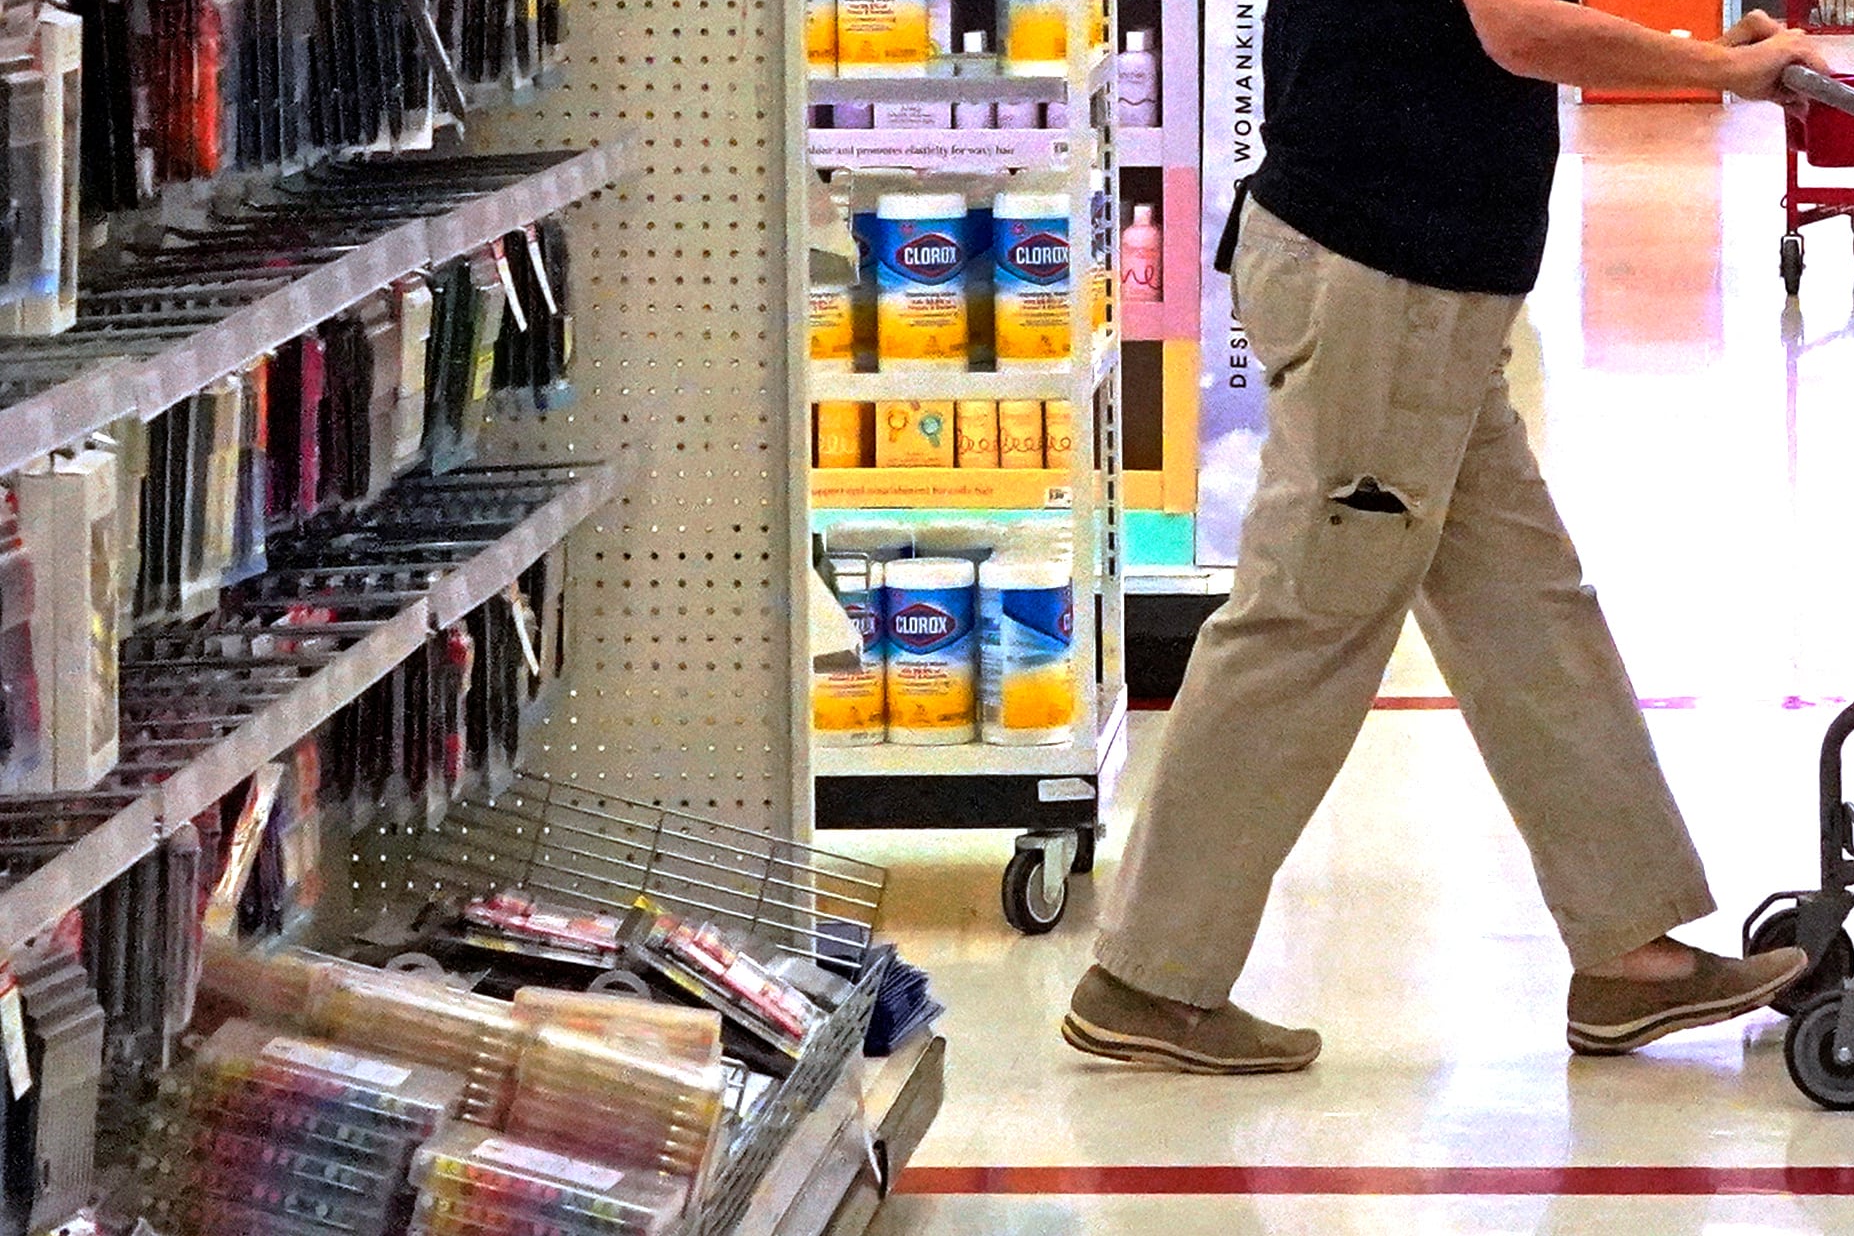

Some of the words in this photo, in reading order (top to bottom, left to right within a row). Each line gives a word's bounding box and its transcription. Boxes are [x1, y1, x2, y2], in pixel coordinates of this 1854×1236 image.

[904, 245, 957, 266] CLOROX
[1016, 245, 1069, 266] CLOROX
[1230, 313, 1248, 389] DESI
[896, 615, 947, 635] CLOROX
